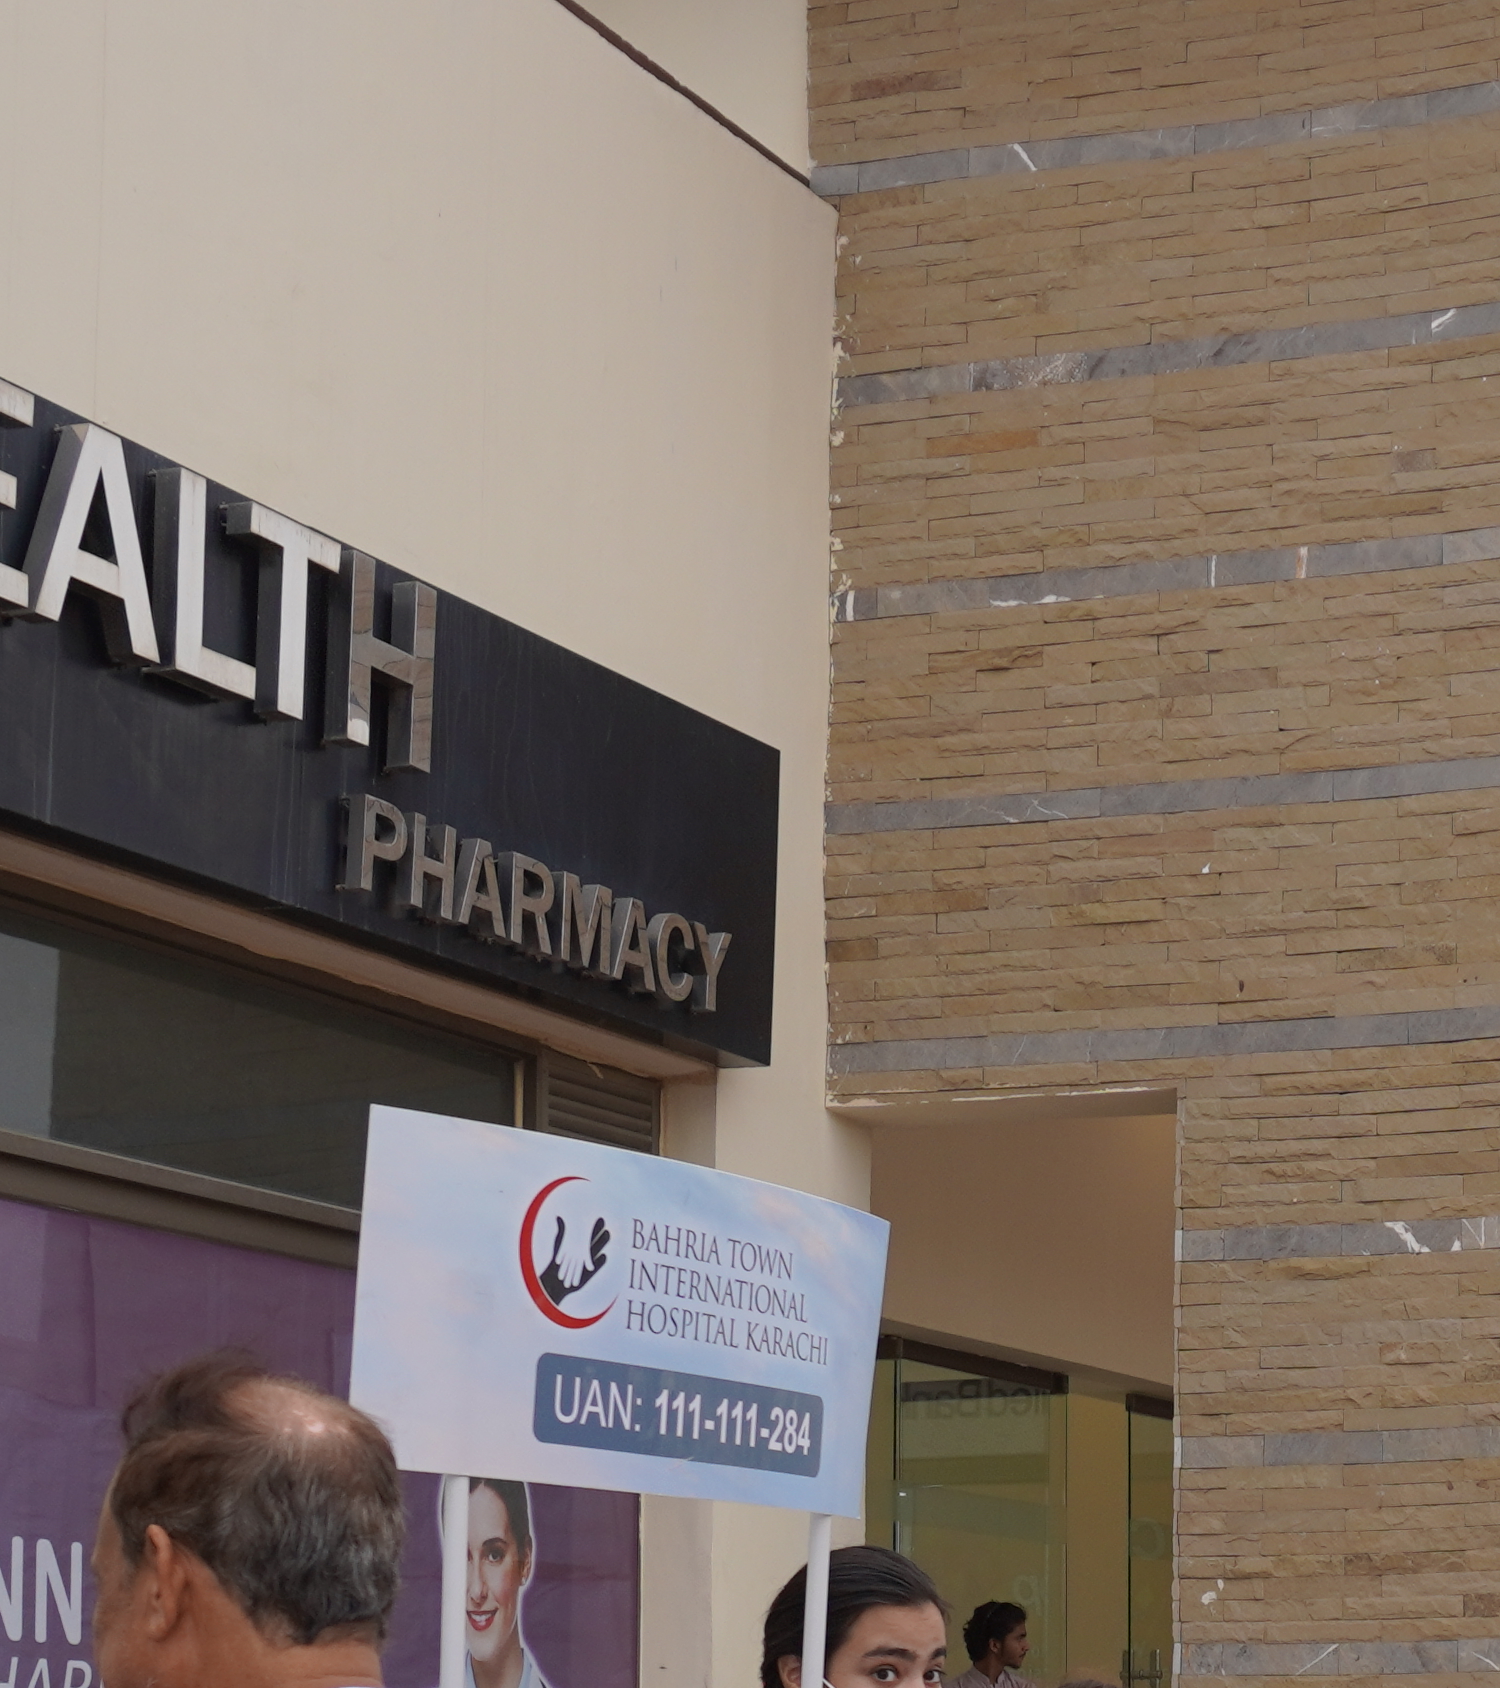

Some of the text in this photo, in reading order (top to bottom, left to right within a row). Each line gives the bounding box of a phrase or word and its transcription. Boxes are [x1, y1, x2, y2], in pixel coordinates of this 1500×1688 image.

[338, 792, 733, 1013] PHARMACY
[631, 1218, 795, 1281] BAHRIA TOWN
[628, 1258, 809, 1324] INTERNATIONAL
[625, 1299, 829, 1367] HOSPITAL KARACHI
[553, 1373, 812, 1457] UAN: 111-111-284
